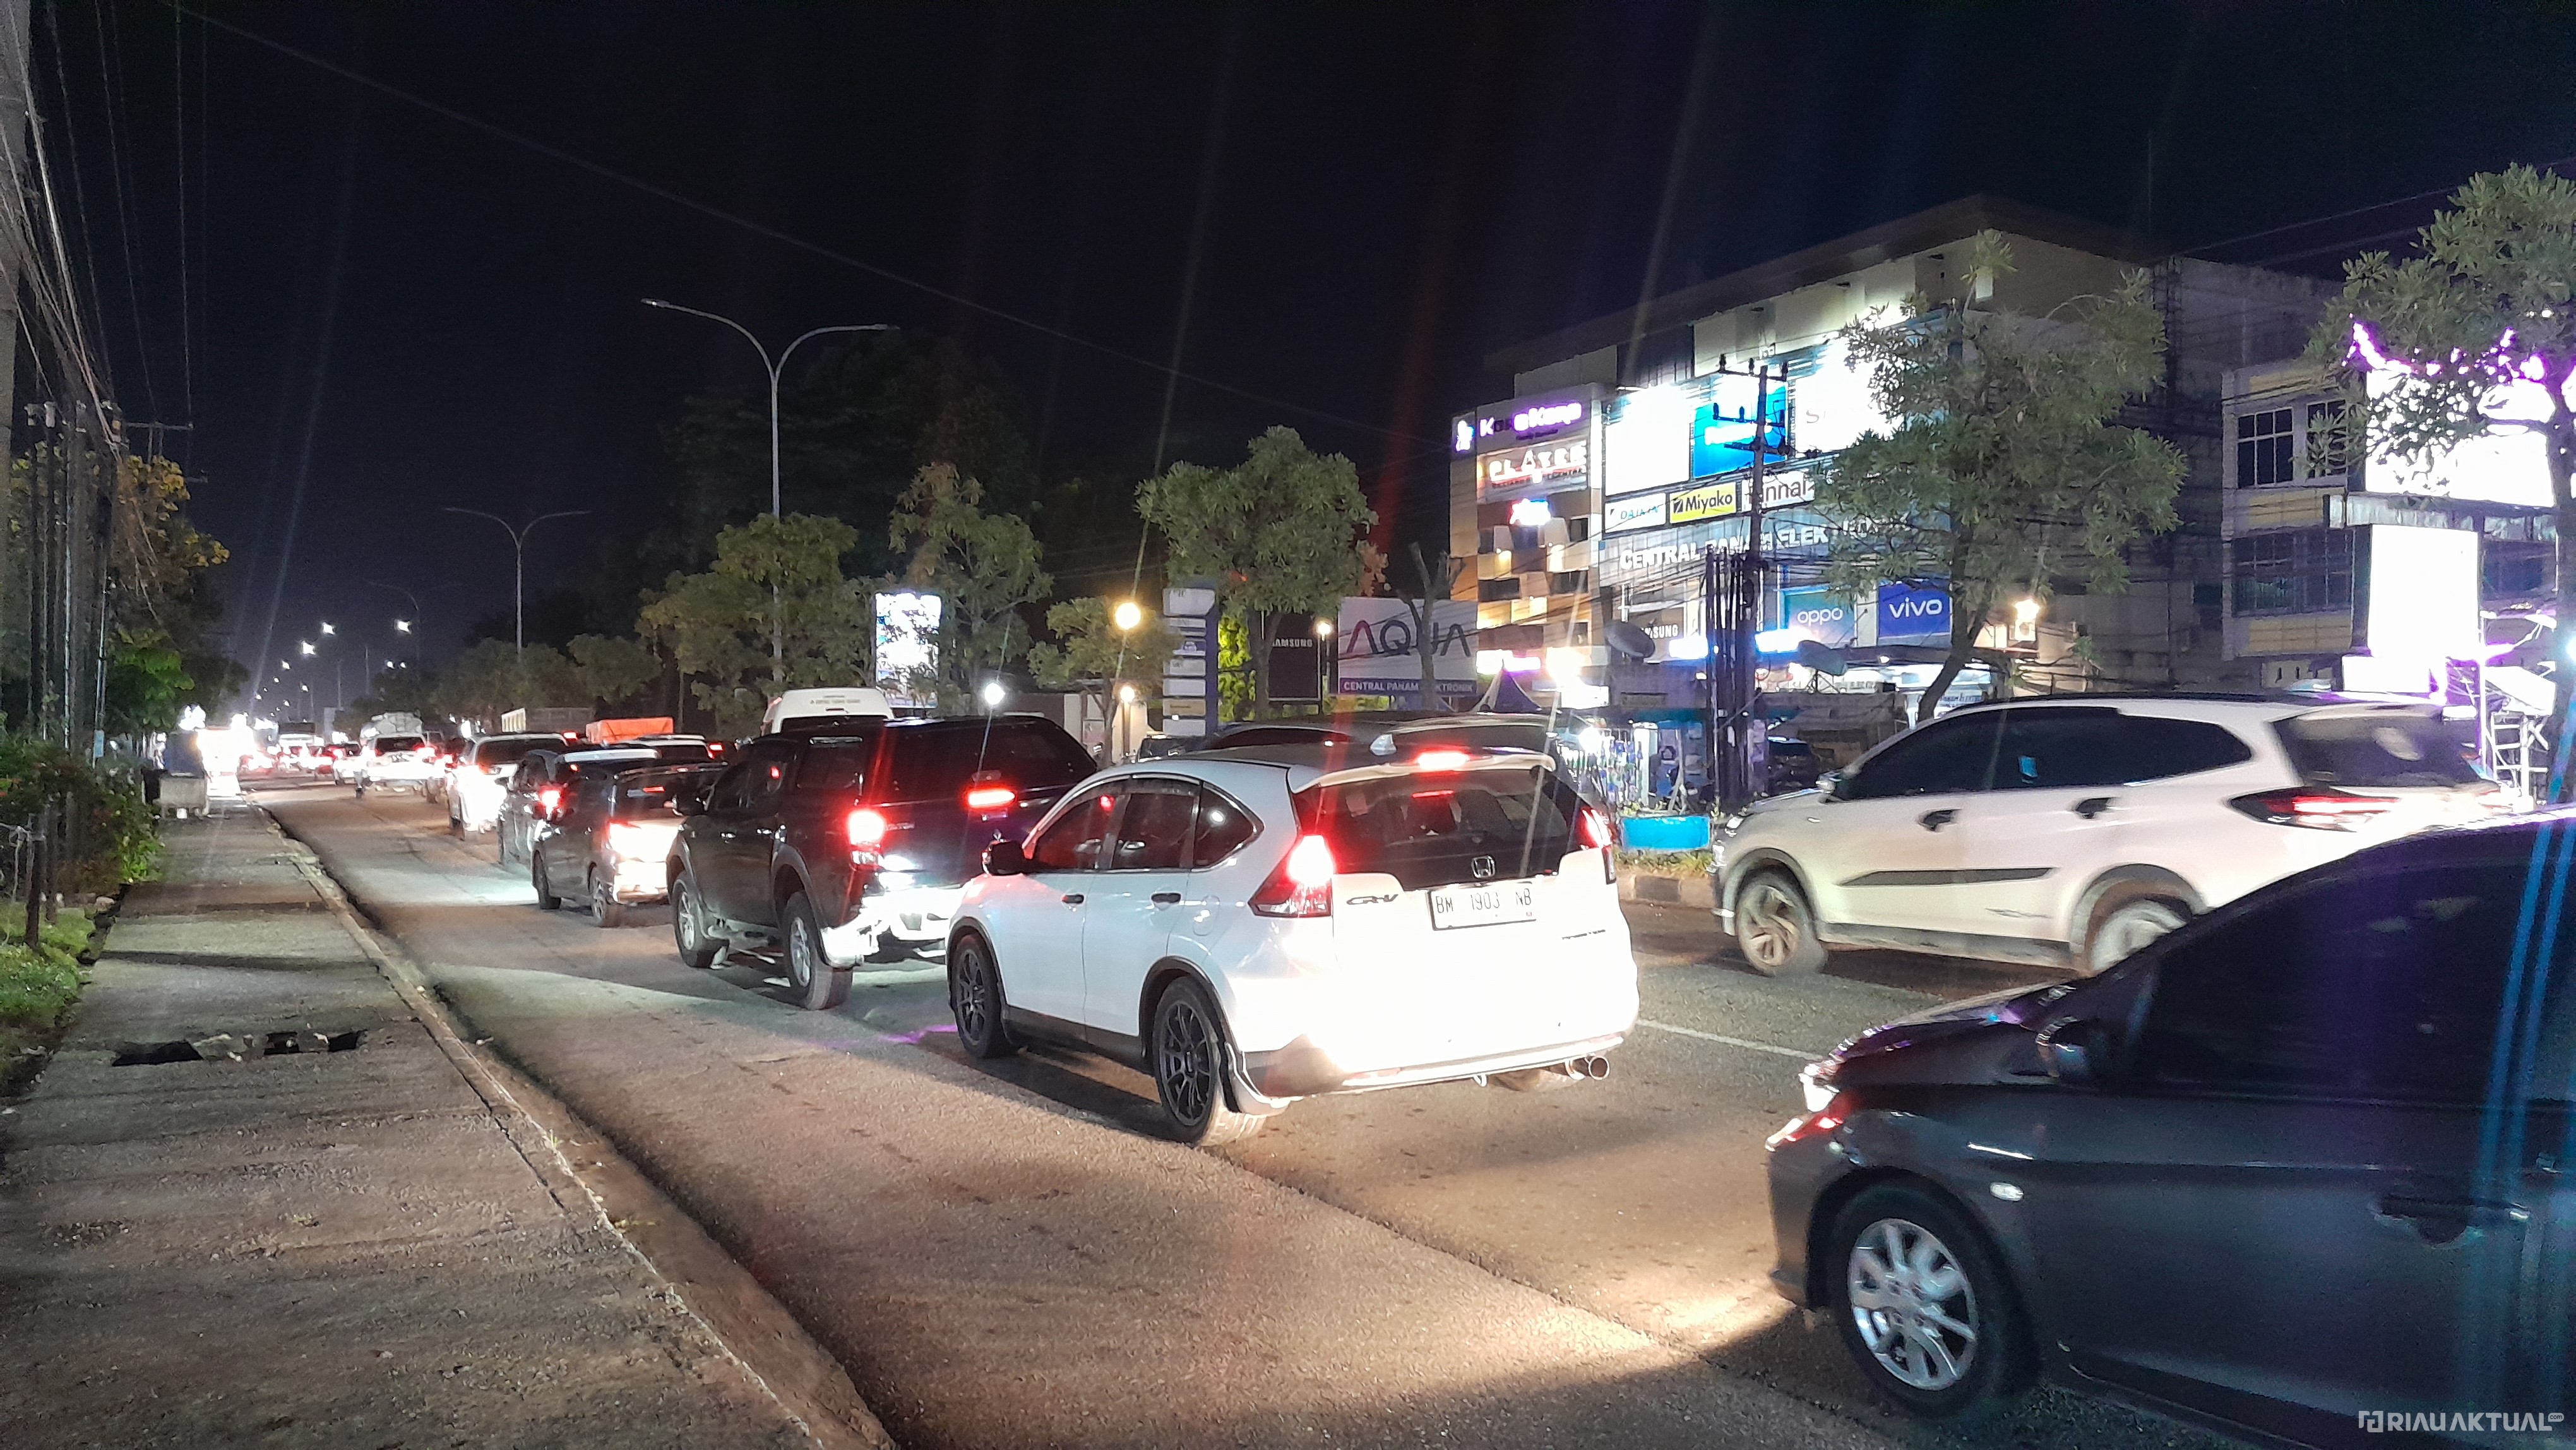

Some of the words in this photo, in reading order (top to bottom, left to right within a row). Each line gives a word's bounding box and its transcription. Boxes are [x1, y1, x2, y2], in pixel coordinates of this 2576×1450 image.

[1686, 490, 1732, 514] Miyako
[1619, 542, 1700, 570] CENTRAL
[1889, 597, 1942, 618] vivo
[1344, 681, 1385, 692] CENTRAL
[1436, 896, 1453, 914] BM
[1471, 892, 1500, 911] 1903
[1516, 888, 1532, 906] NB
